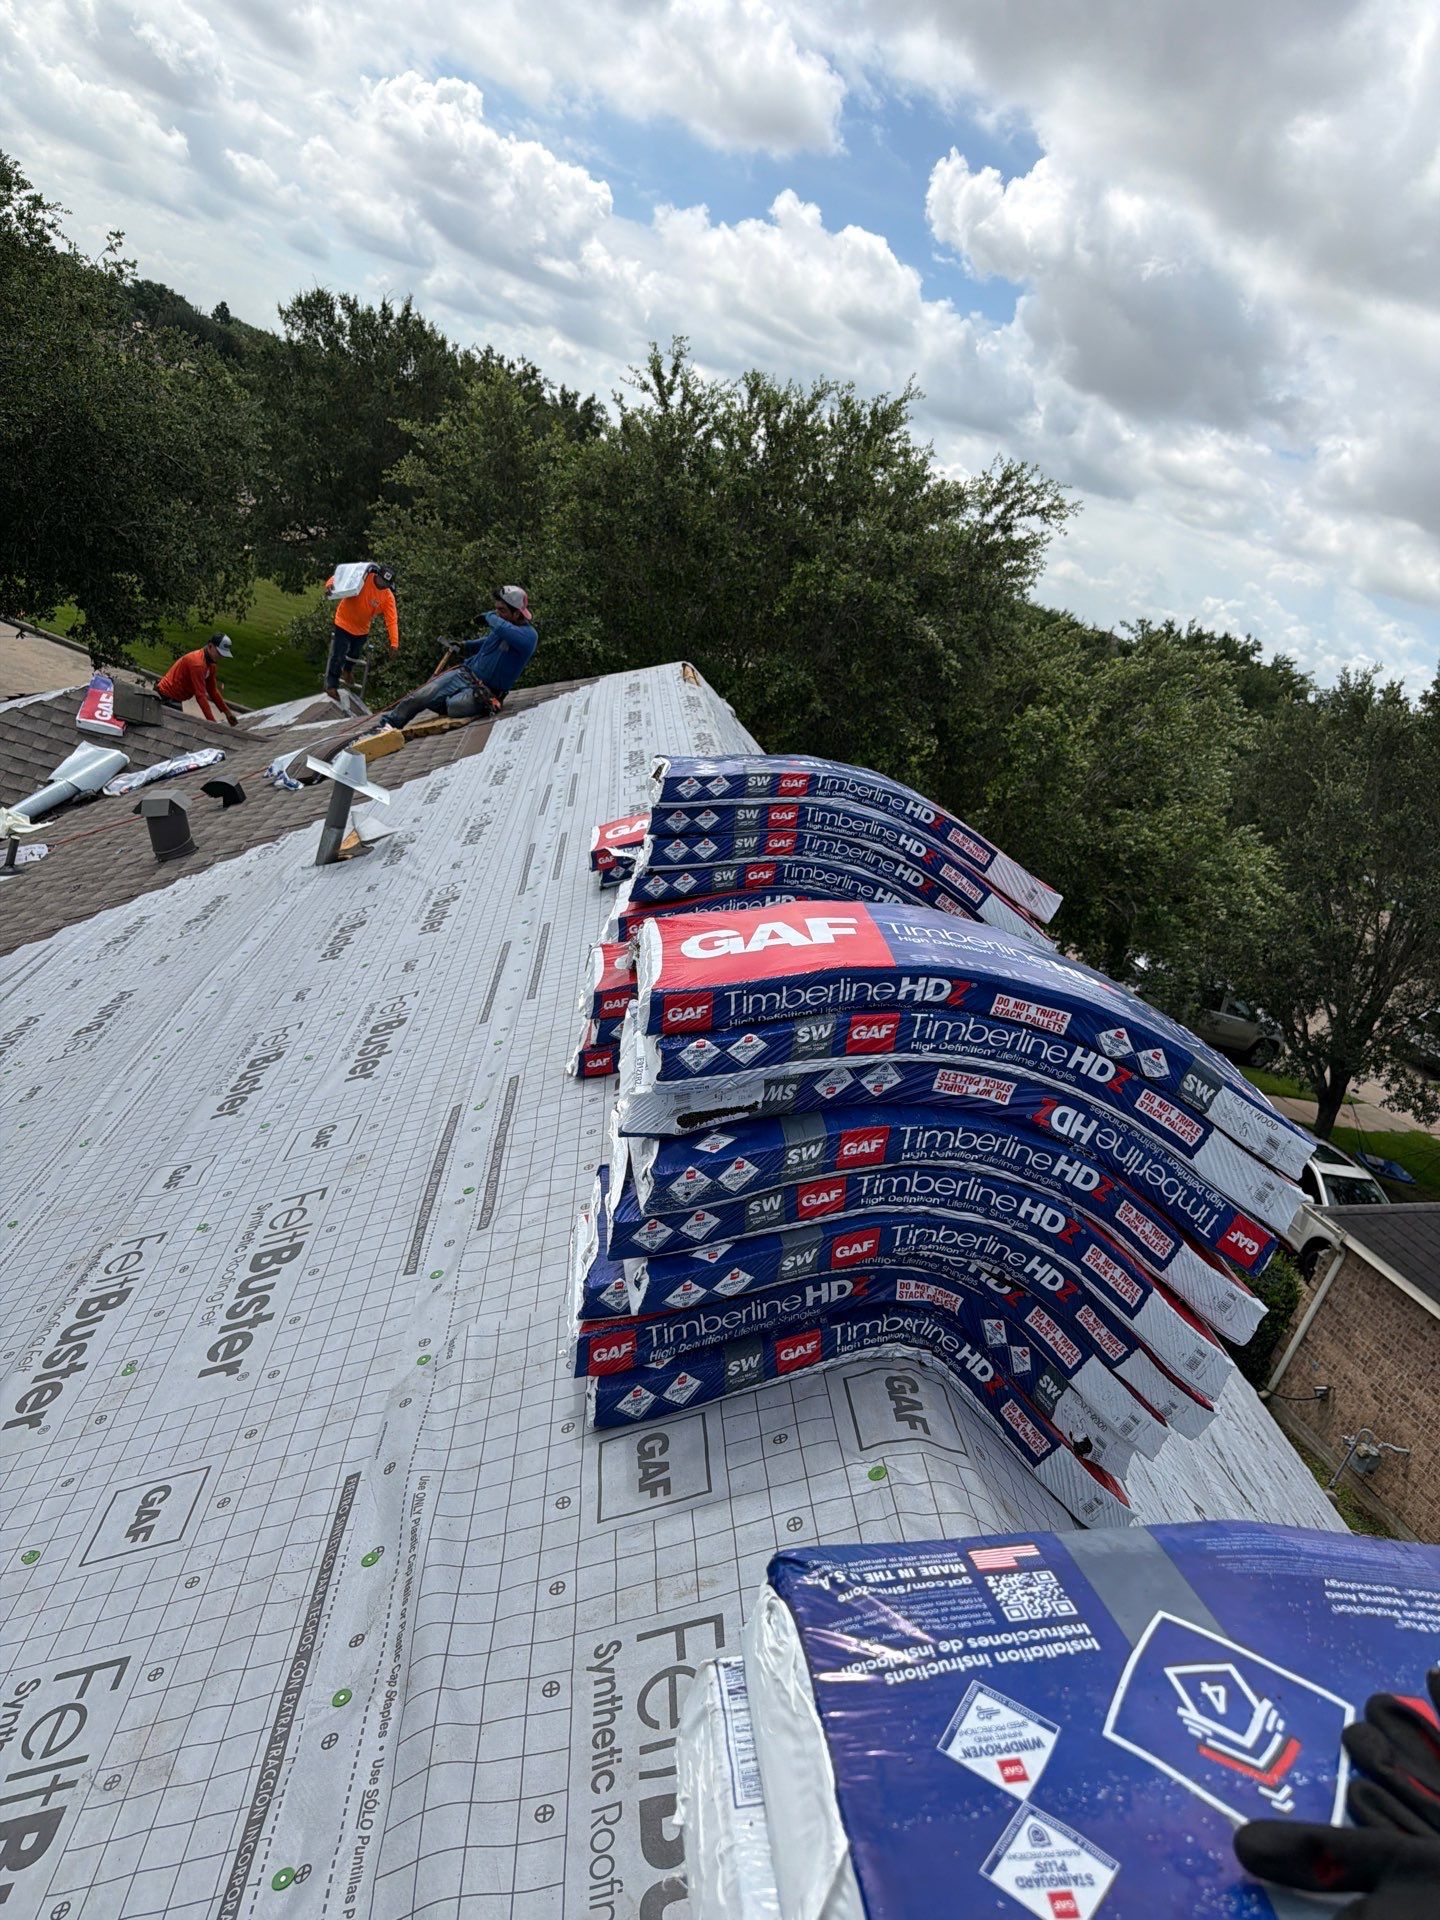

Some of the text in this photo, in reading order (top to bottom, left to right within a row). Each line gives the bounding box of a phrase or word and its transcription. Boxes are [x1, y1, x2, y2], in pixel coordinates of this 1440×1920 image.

[748, 777, 770, 786] SW
[781, 779, 807, 788] GAF
[816, 773, 905, 810] Timberline
[605, 818, 650, 839] GA
[737, 809, 759, 819] SW
[771, 812, 796, 821] GAF
[805, 807, 898, 842] Timberline
[735, 837, 758, 848] SW
[769, 839, 794, 848] GAF
[803, 834, 895, 872] Timberline
[714, 862, 874, 898] SW GAF Timberline
[680, 918, 859, 959] GAF
[880, 922, 1050, 965] Timberline
[898, 936, 929, 944] High
[604, 998, 629, 1010] GAF
[667, 1005, 708, 1022] GAF
[725, 977, 895, 1016] Timberline
[996, 996, 1068, 1023] DO NOT TRIPLE
[344, 990, 420, 1083] FeltBuster
[992, 1006, 1064, 1033] STACK PALLETS
[796, 1021, 833, 1042] SW
[852, 1024, 895, 1040] GAF
[911, 1014, 1067, 1064] Timberline
[210, 1022, 304, 1120] FeltBuster
[587, 1058, 610, 1068] GAF
[911, 1041, 1076, 1082] High Shingles
[764, 1084, 798, 1101] MS
[937, 1081, 1008, 1103] DO NOT TRIPLE
[940, 1071, 1013, 1093] STACK PALLETS
[1182, 1074, 1215, 1103] SW
[1138, 1100, 1164, 1121] STACK
[1162, 1115, 1197, 1143] PALLETS
[1142, 1092, 1156, 1104] DO
[1156, 1100, 1173, 1116] NOT
[1172, 1110, 1203, 1137] TRIPLE
[311, 1124, 338, 1149] GAF
[787, 1142, 823, 1164] SW
[843, 1139, 883, 1156] GAF
[900, 1126, 1052, 1171] Timberline
[1089, 1105, 1226, 1211] High Shingles
[161, 1164, 192, 1191] GAF
[749, 1195, 782, 1216] SW
[801, 1189, 843, 1207] GAF
[857, 1171, 1018, 1212] Timberline
[1023, 1168, 1062, 1189] Shingles
[1096, 1129, 1219, 1239] Timberline
[860, 1197, 1029, 1231] High Shingles
[1122, 1203, 1174, 1249] DO NOT TRIPLE
[780, 1249, 817, 1271] SW
[836, 1239, 875, 1259] GAF
[891, 1224, 1026, 1266] Timberline
[1118, 1210, 1168, 1257] STACK PALLETS
[1228, 1230, 1259, 1255] GAF
[197, 1202, 273, 1328] Synthetic Roofing Felt
[1085, 1255, 1137, 1305] STACK PALLETS
[1090, 1247, 1142, 1298] DO NOT TRIPLE
[592, 1342, 633, 1362] GAF
[645, 1294, 802, 1348] Timberline
[728, 1314, 959, 1377] SW GAF Timberline
[1029, 1315, 1075, 1366] STACK PALLETS
[1034, 1309, 1081, 1359] DO NOT TRIPLE
[884, 1374, 932, 1436] GAF
[1039, 1374, 1063, 1400] SW
[417, 1475, 430, 1491] Use
[636, 1431, 672, 1499] GAF
[124, 1484, 173, 1544] GAF
[410, 1492, 426, 1517] ONLY
[409, 1517, 421, 1552] Plastic
[405, 1554, 416, 1576] Cap
[862, 1562, 968, 1582] MADE IN THE
[314, 1572, 332, 1603] PARA
[401, 1579, 414, 1606] Nails
[399, 1607, 407, 1620] or
[938, 1622, 1091, 1654] Instrucciones de
[290, 1660, 307, 1689] CON
[386, 1664, 401, 1688] Cap
[884, 1638, 1101, 1686] Installation instructions
[377, 1690, 398, 1739] Staples
[586, 1639, 623, 1794] Synthetic
[1006, 1720, 1028, 1729] SPEED
[251, 1693, 298, 1820] EXTRA-TRACCIÓN
[973, 1735, 994, 1743] WIND
[369, 1757, 385, 1786] Use
[1002, 1765, 1024, 1775] GAF
[356, 1787, 380, 1830] SÓLO
[344, 1835, 371, 1905] Puntillas
[1015, 1873, 1095, 1888] STAINGUARD
[1053, 1899, 1075, 1910] GAF
